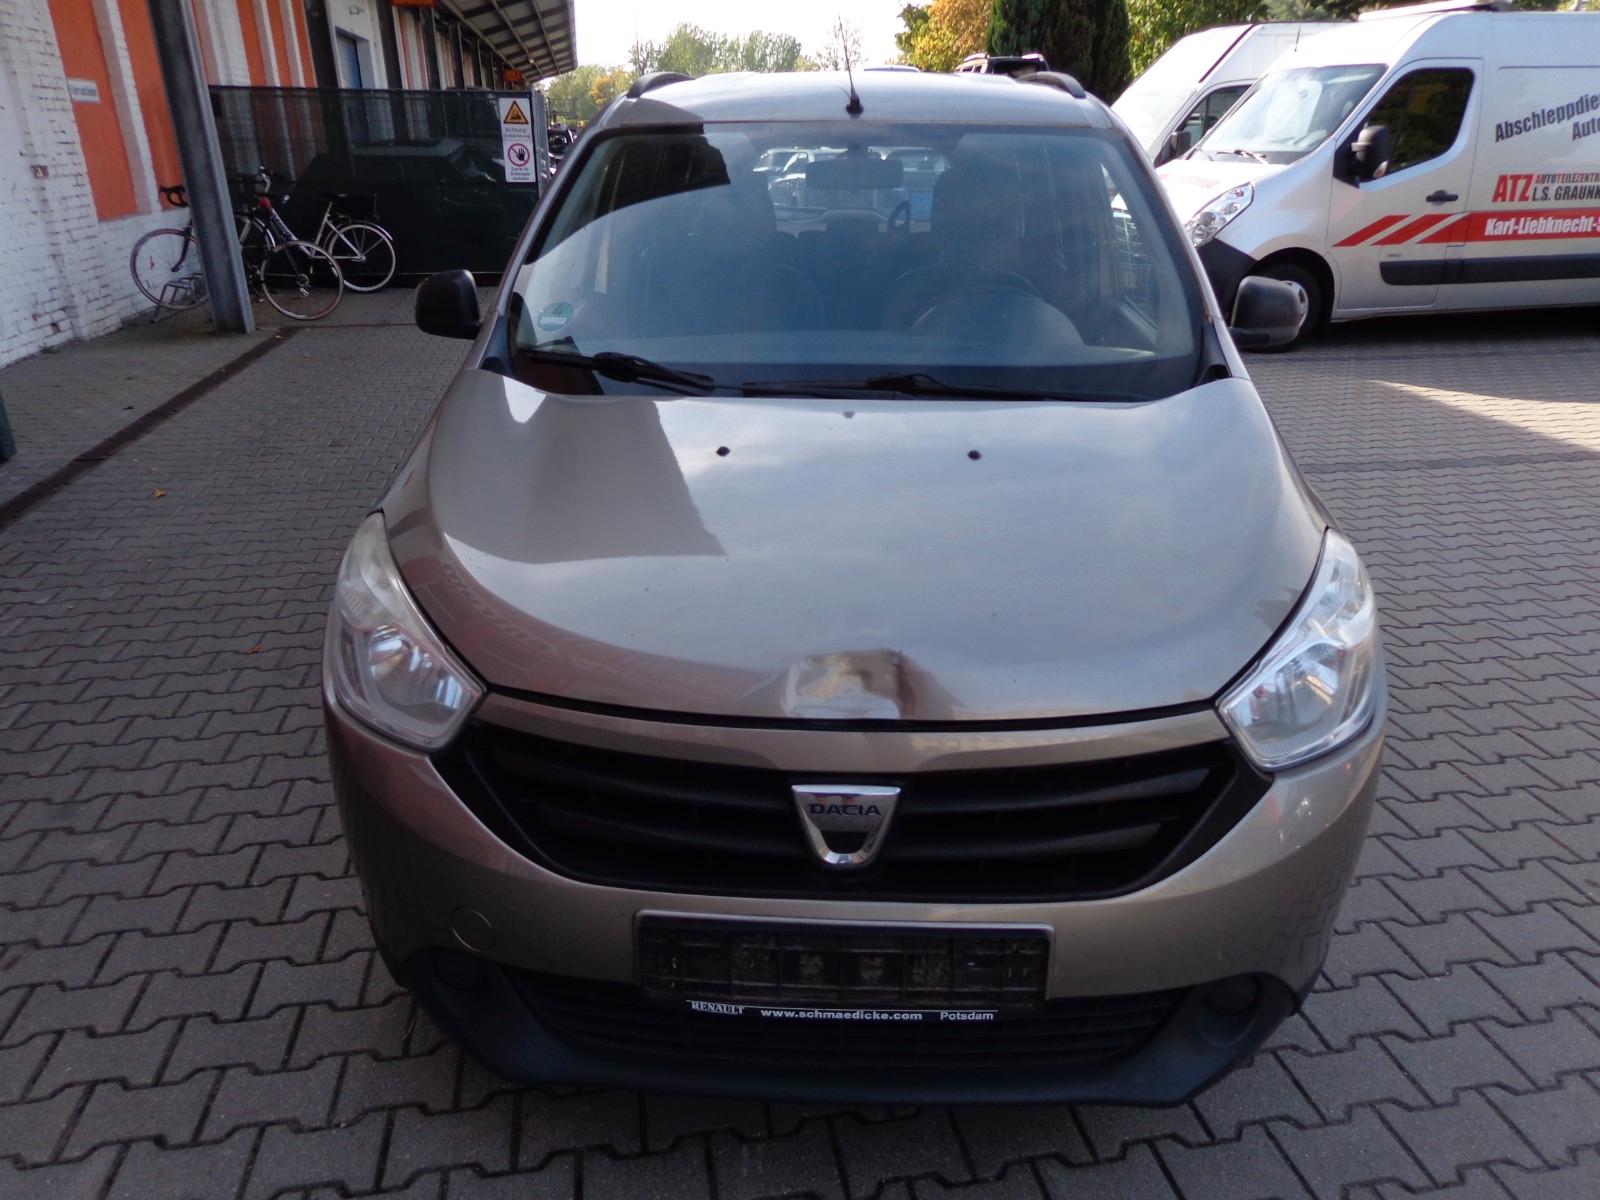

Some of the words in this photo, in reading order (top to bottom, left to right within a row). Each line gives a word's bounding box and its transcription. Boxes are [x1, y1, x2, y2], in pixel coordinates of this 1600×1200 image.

[1495, 92, 1600, 142] Abschleppdie
[1491, 174, 1535, 203] ATZ
[1532, 186, 1551, 201] L.S.
[808, 803, 880, 815] DACIA
[691, 1001, 744, 1015] RENAULT
[761, 1008, 923, 1020] www.schmaedicke.com
[940, 1011, 994, 1020] Potsdam
